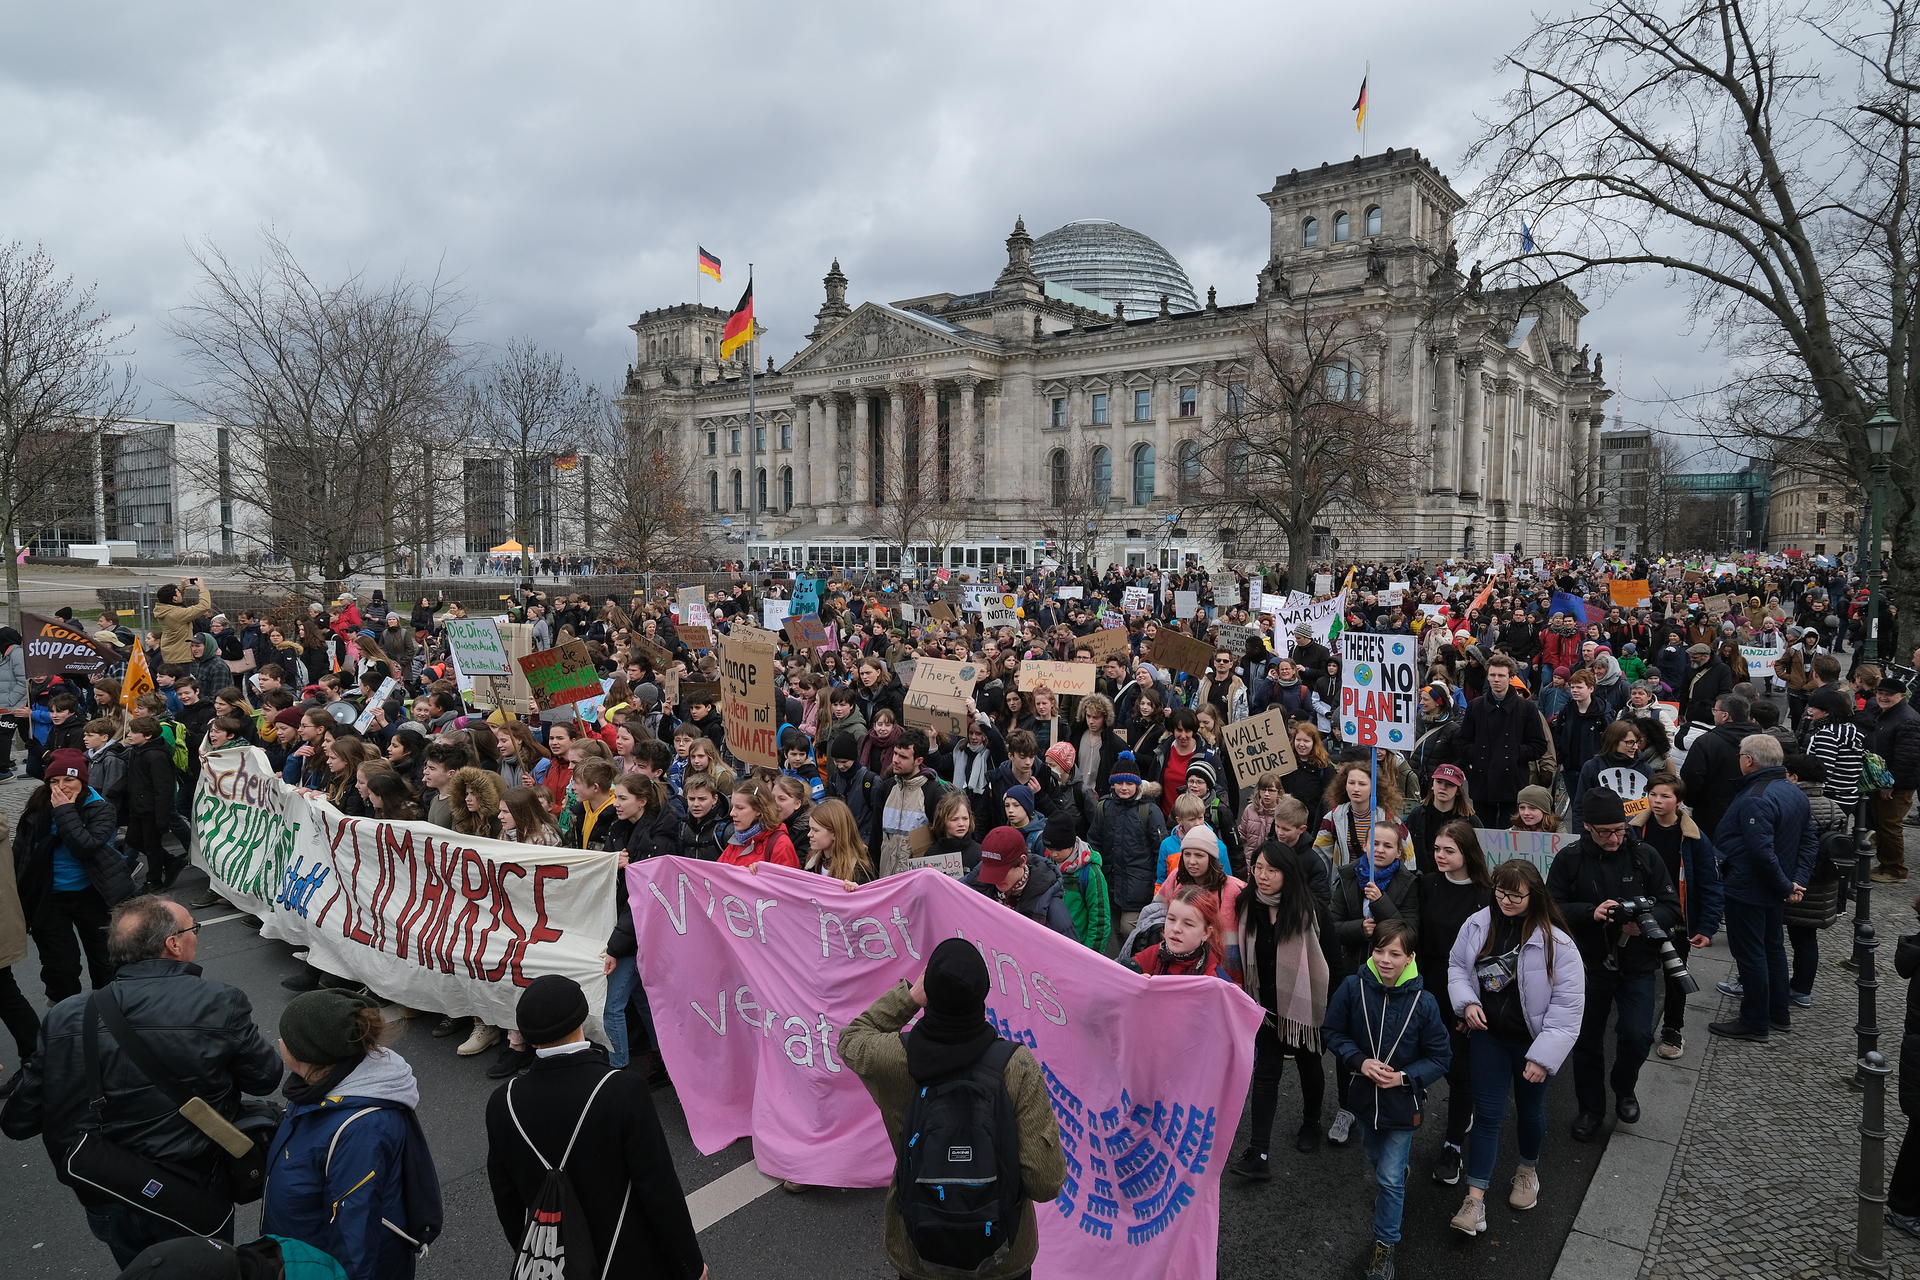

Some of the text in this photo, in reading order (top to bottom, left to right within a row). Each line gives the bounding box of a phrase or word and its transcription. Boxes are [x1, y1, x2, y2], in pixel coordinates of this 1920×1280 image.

[855, 373, 891, 384] DEUTSCHEN
[984, 596, 1000, 607] YOU
[987, 609, 1004, 620] NOT
[1278, 599, 1336, 626] WARUM?
[447, 621, 467, 639] Die
[465, 621, 493, 640] Dinos
[1233, 632, 1249, 640] KIND
[1227, 639, 1245, 647] WERD
[1344, 634, 1385, 664] THERE'S
[720, 643, 757, 696] Change
[921, 662, 956, 685] There
[1025, 662, 1072, 673] BLA BLA
[1037, 671, 1054, 679] BLA
[1380, 662, 1414, 693] NO
[953, 686, 962, 698] is
[1025, 678, 1086, 690] ACT NOW
[910, 693, 929, 708] NO
[1342, 687, 1413, 724] PLANET
[754, 702, 770, 723] not
[951, 716, 961, 735] B
[1357, 716, 1378, 746] B
[728, 718, 776, 758] CLIMATE
[1234, 741, 1269, 760] IS OUR
[1237, 750, 1288, 781] FUTURE
[1485, 830, 1561, 854] MIT DER
[316, 811, 569, 988] KLIMAKRISE
[648, 873, 778, 944] Wer
[811, 898, 921, 961] hat
[690, 985, 841, 1073] verat
